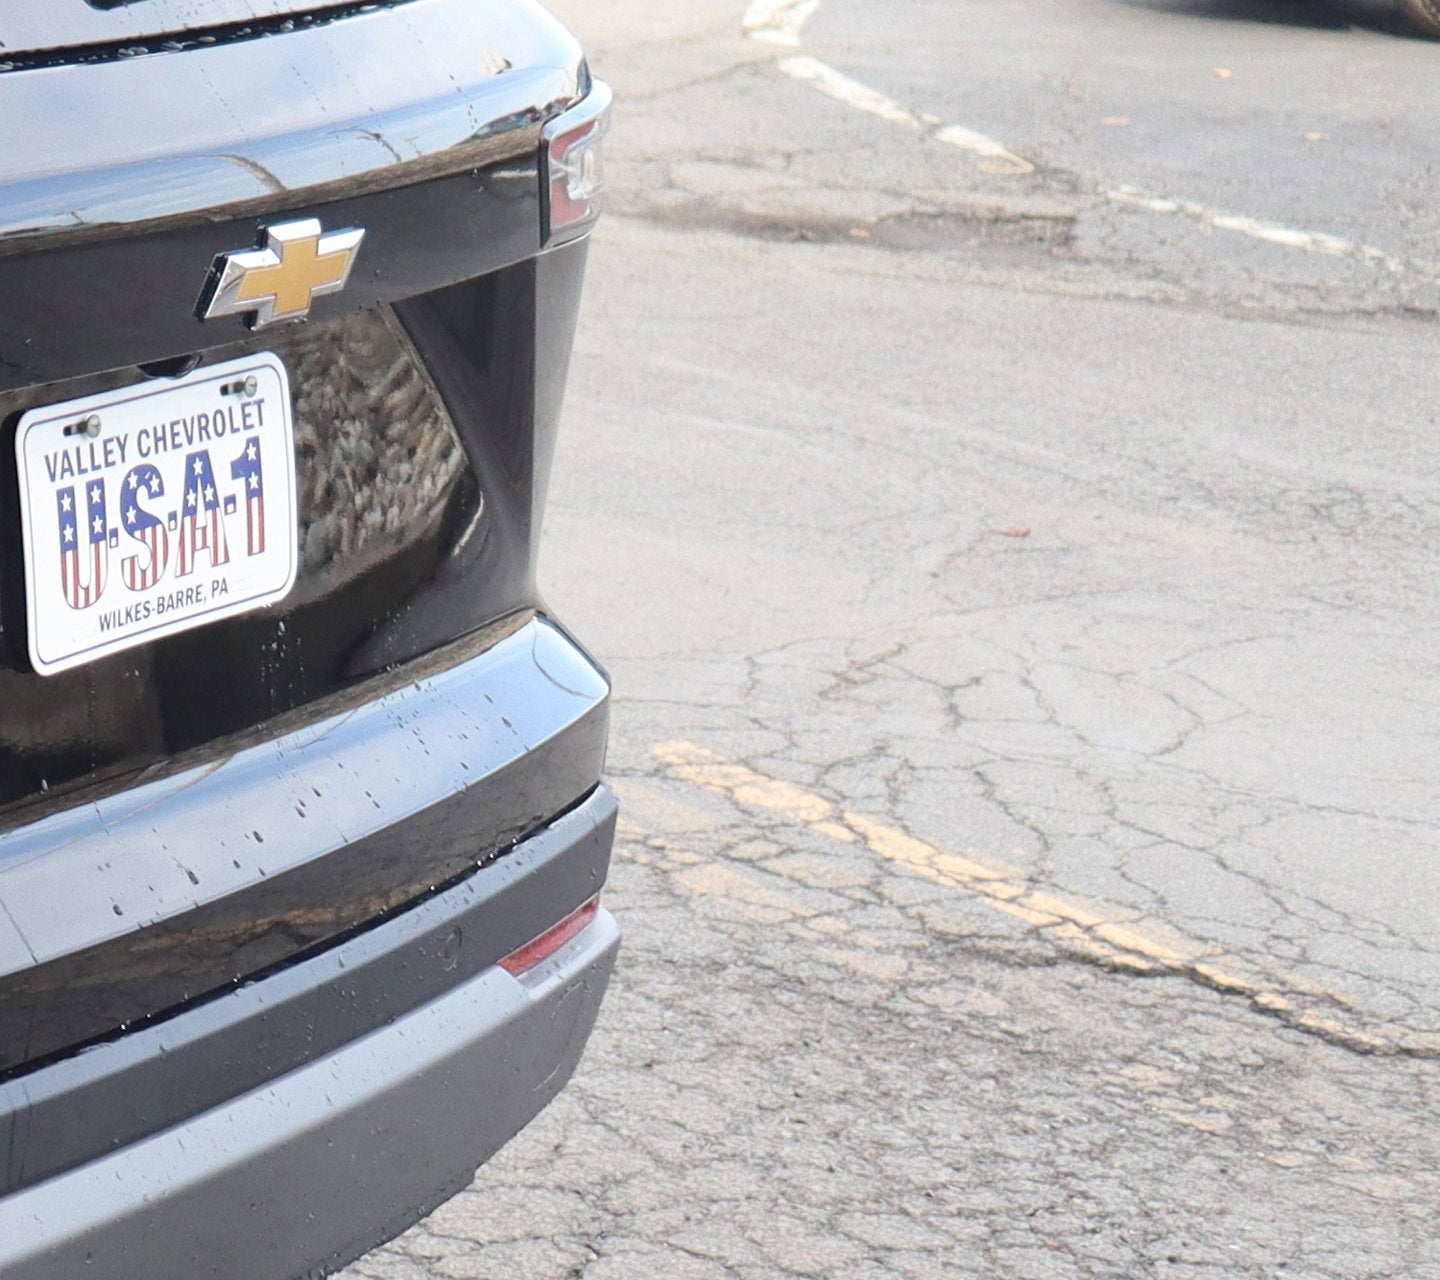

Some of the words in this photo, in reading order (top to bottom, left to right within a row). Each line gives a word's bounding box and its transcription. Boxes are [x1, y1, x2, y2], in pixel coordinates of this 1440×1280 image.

[45, 433, 128, 483] VALLEY
[137, 398, 265, 458] CHEVROLET
[98, 584, 207, 633] WILKES-BARRE,
[211, 577, 229, 596] PA
